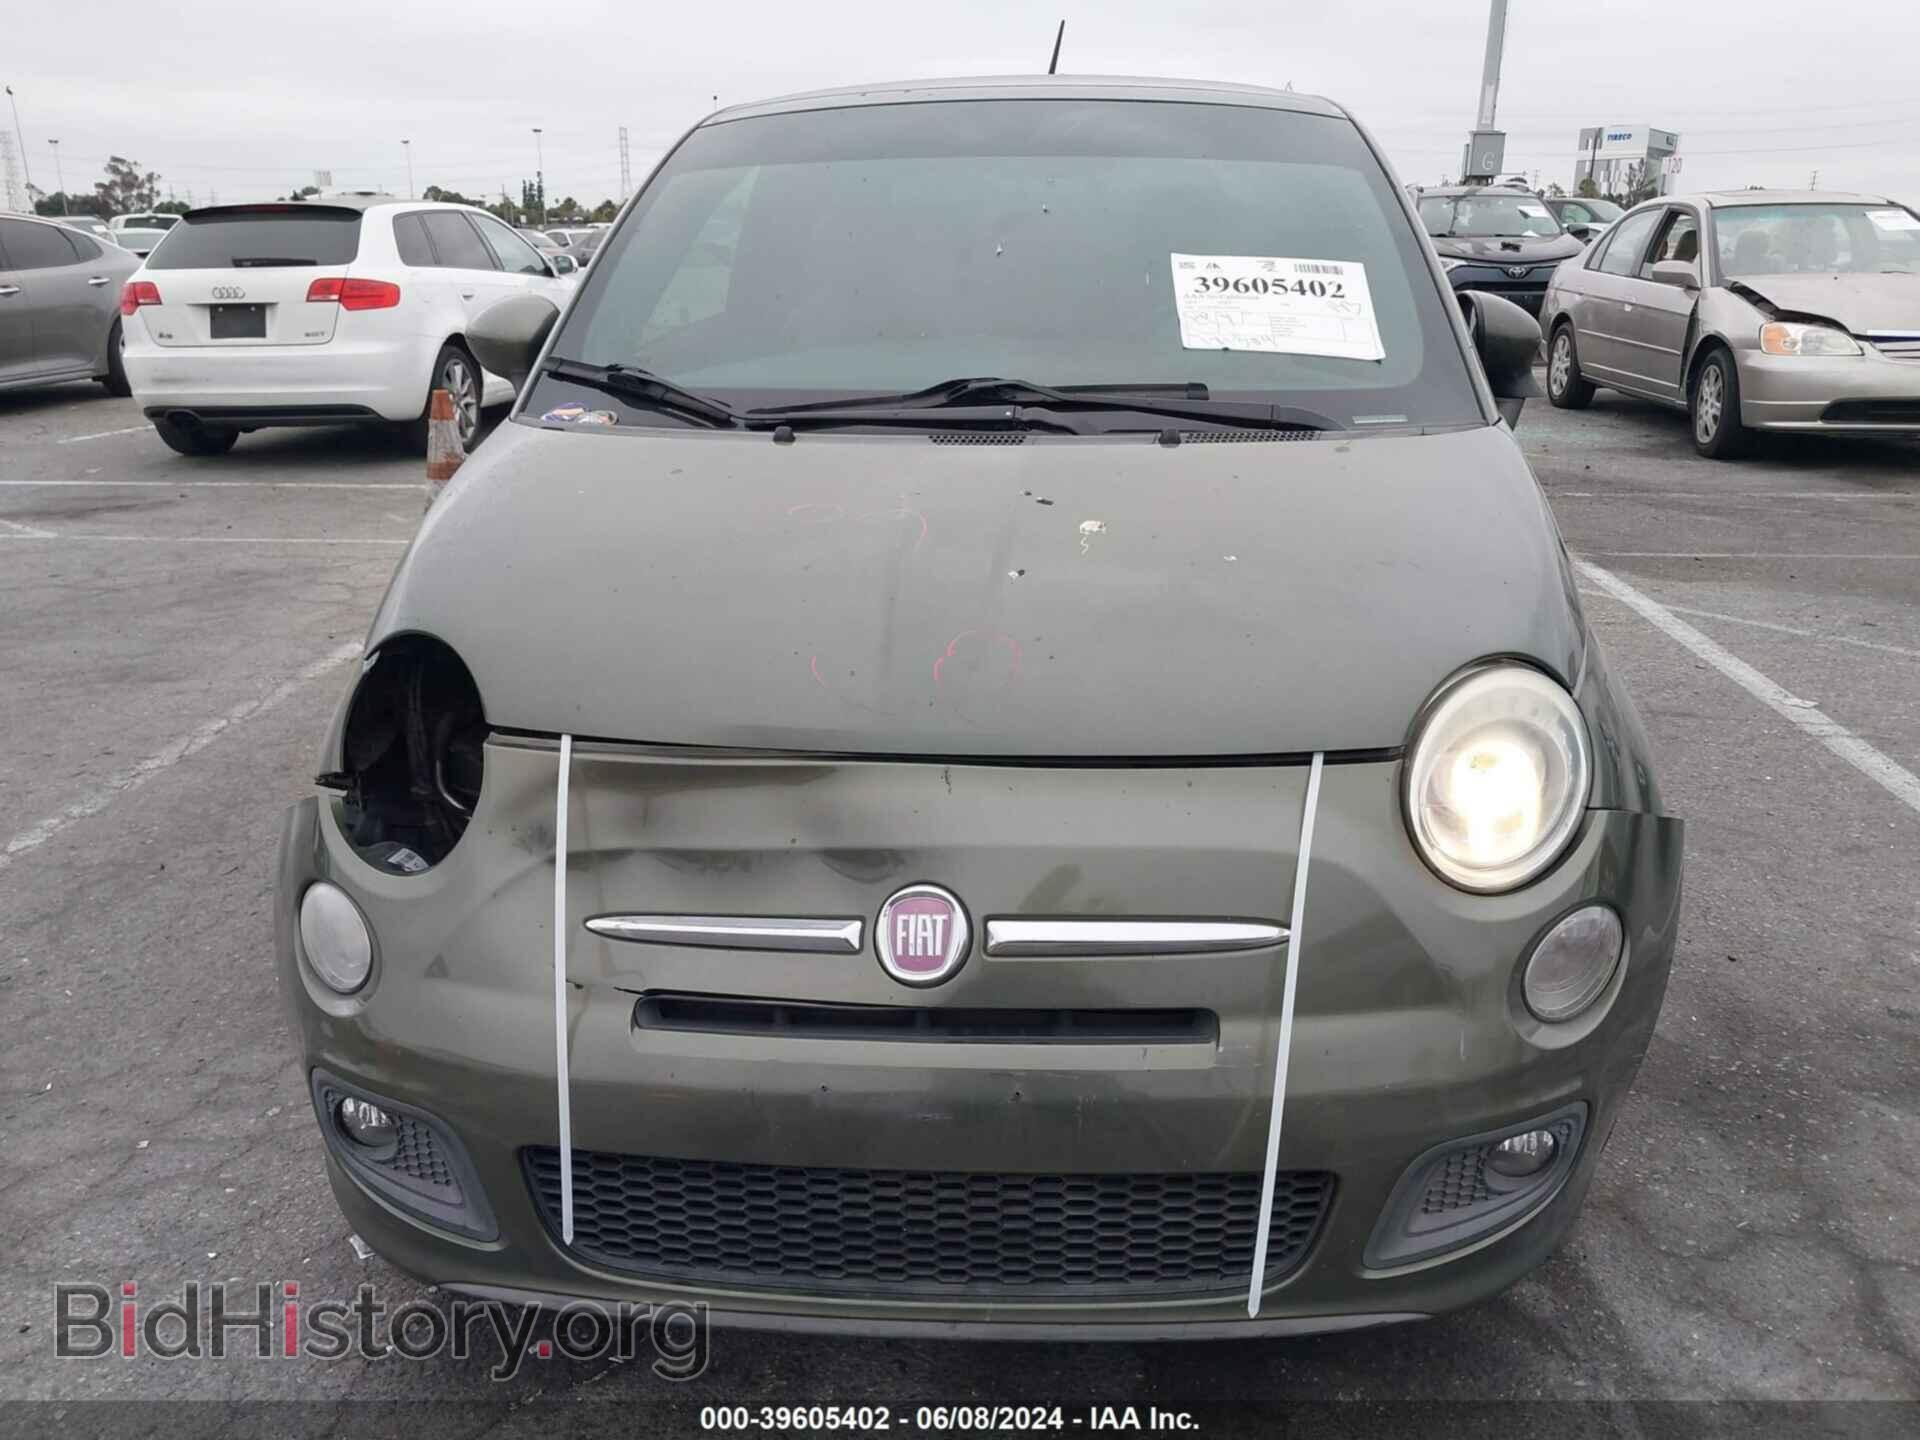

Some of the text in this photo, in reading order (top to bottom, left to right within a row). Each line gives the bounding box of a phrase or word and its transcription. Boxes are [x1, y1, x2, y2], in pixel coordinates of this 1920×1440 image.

[1482, 152, 1495, 170] G
[1193, 276, 1345, 298] 39605402
[896, 914, 948, 956] FIAT
